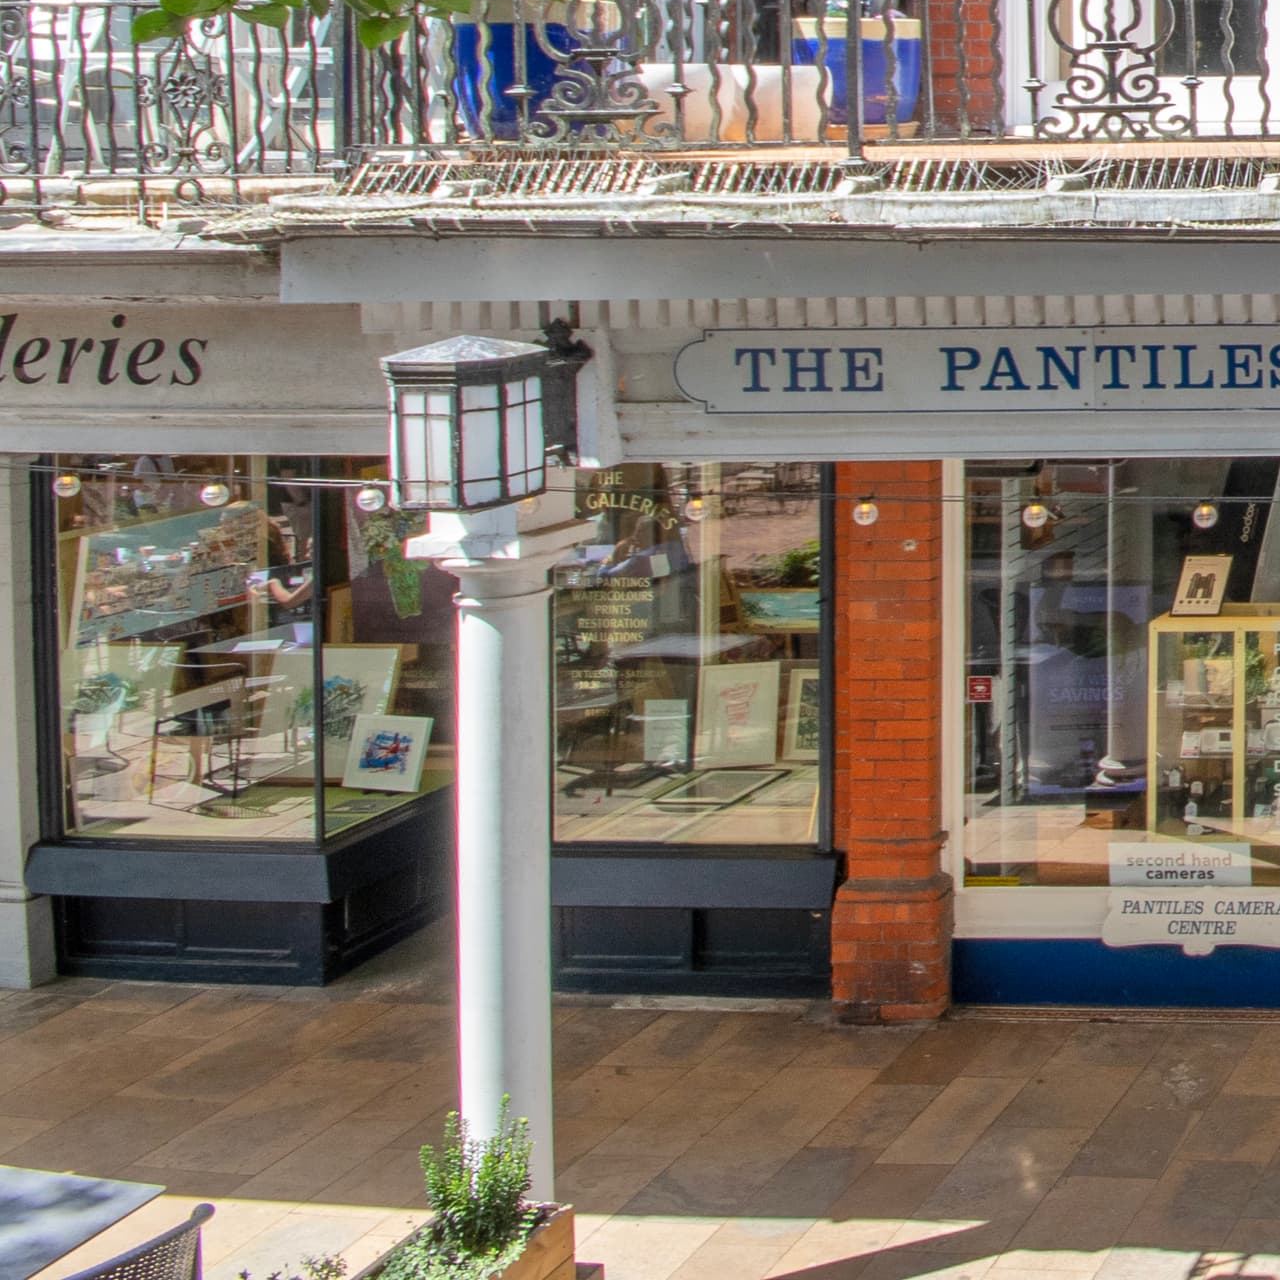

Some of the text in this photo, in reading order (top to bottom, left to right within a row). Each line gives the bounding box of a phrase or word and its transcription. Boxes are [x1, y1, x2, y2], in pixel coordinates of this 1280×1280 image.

[735, 347, 884, 393] THE
[596, 471, 624, 485] THE
[586, 493, 678, 530] GALLERIES
[599, 576, 651, 588] PAINTINGS
[572, 590, 655, 601] WATERCOLOURS
[595, 605, 632, 615] PRINTS
[578, 619, 649, 629] RESTORATION
[580, 632, 644, 642] VALUATIONS
[1127, 853, 1232, 867] second hand
[1146, 868, 1215, 880] cameras
[1121, 900, 1204, 915] PANTILES
[1167, 920, 1237, 936] CENTRE
